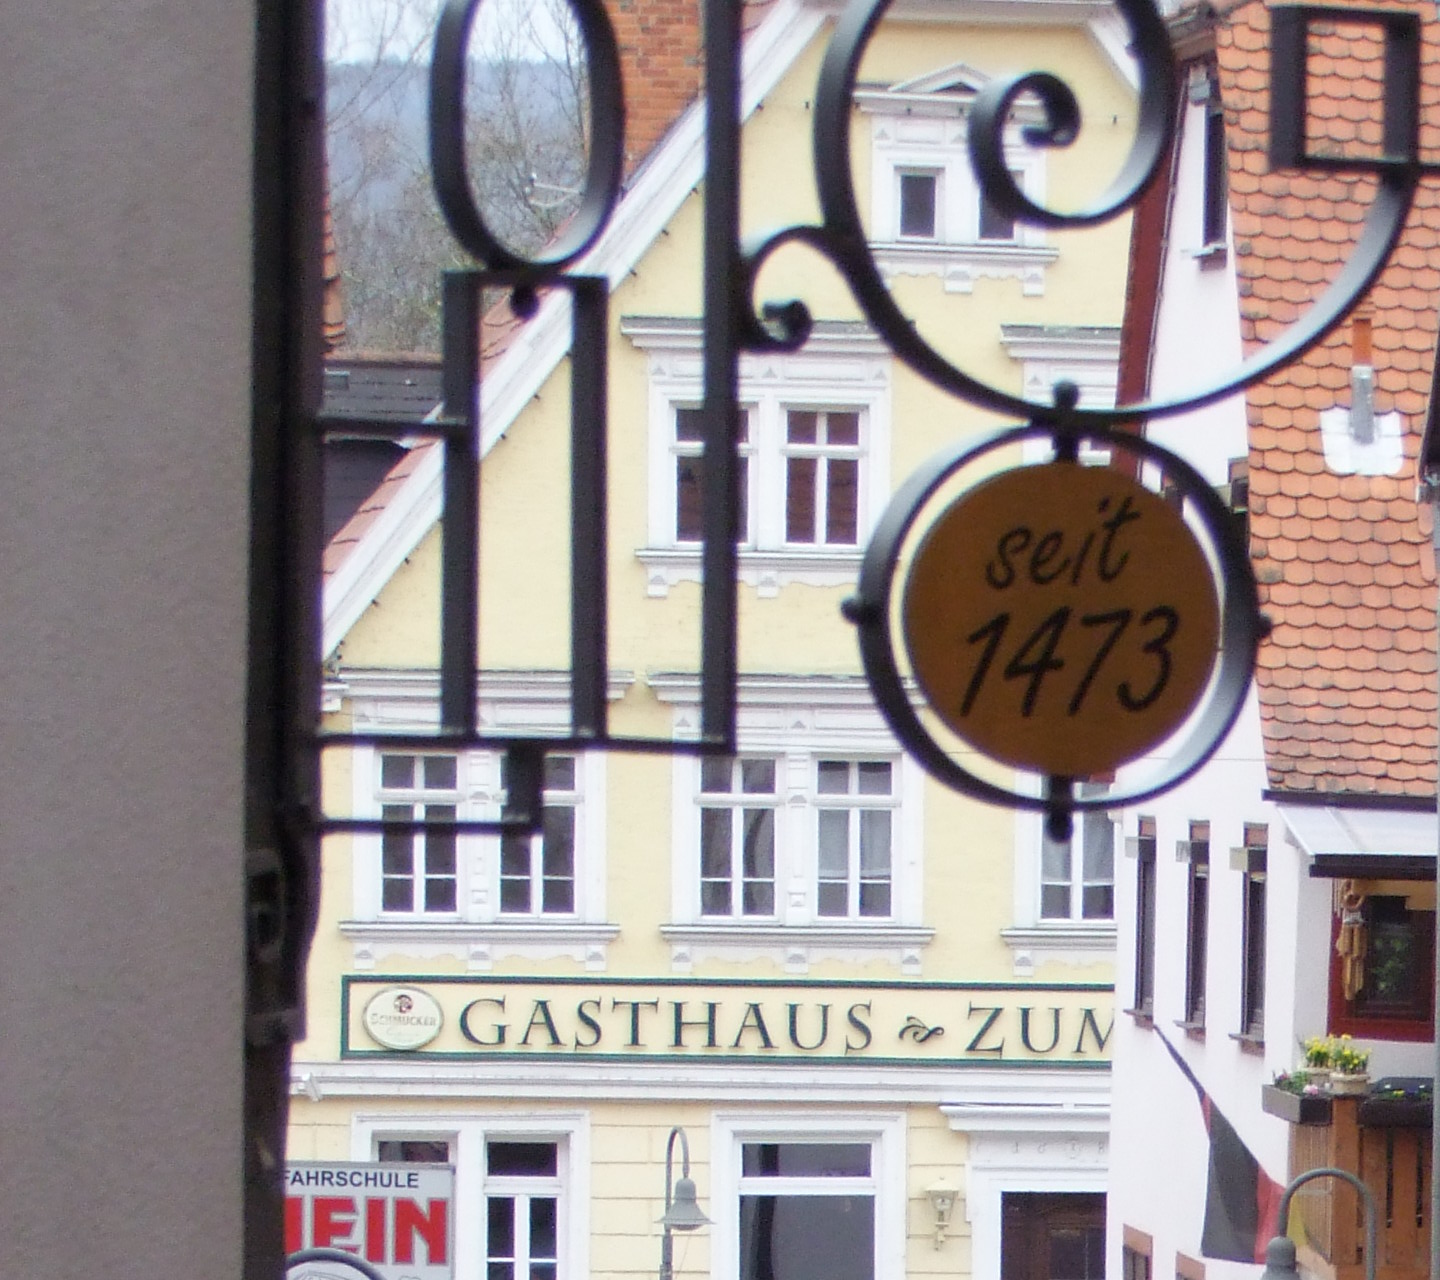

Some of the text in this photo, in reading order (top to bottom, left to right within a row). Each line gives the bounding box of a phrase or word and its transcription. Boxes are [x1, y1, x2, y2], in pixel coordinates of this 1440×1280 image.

[985, 496, 1141, 590] seit
[960, 605, 1180, 718] 1473
[459, 994, 1115, 1058] GASTHAUS ZUM
[284, 1170, 419, 1189] FAHRSCHULE
